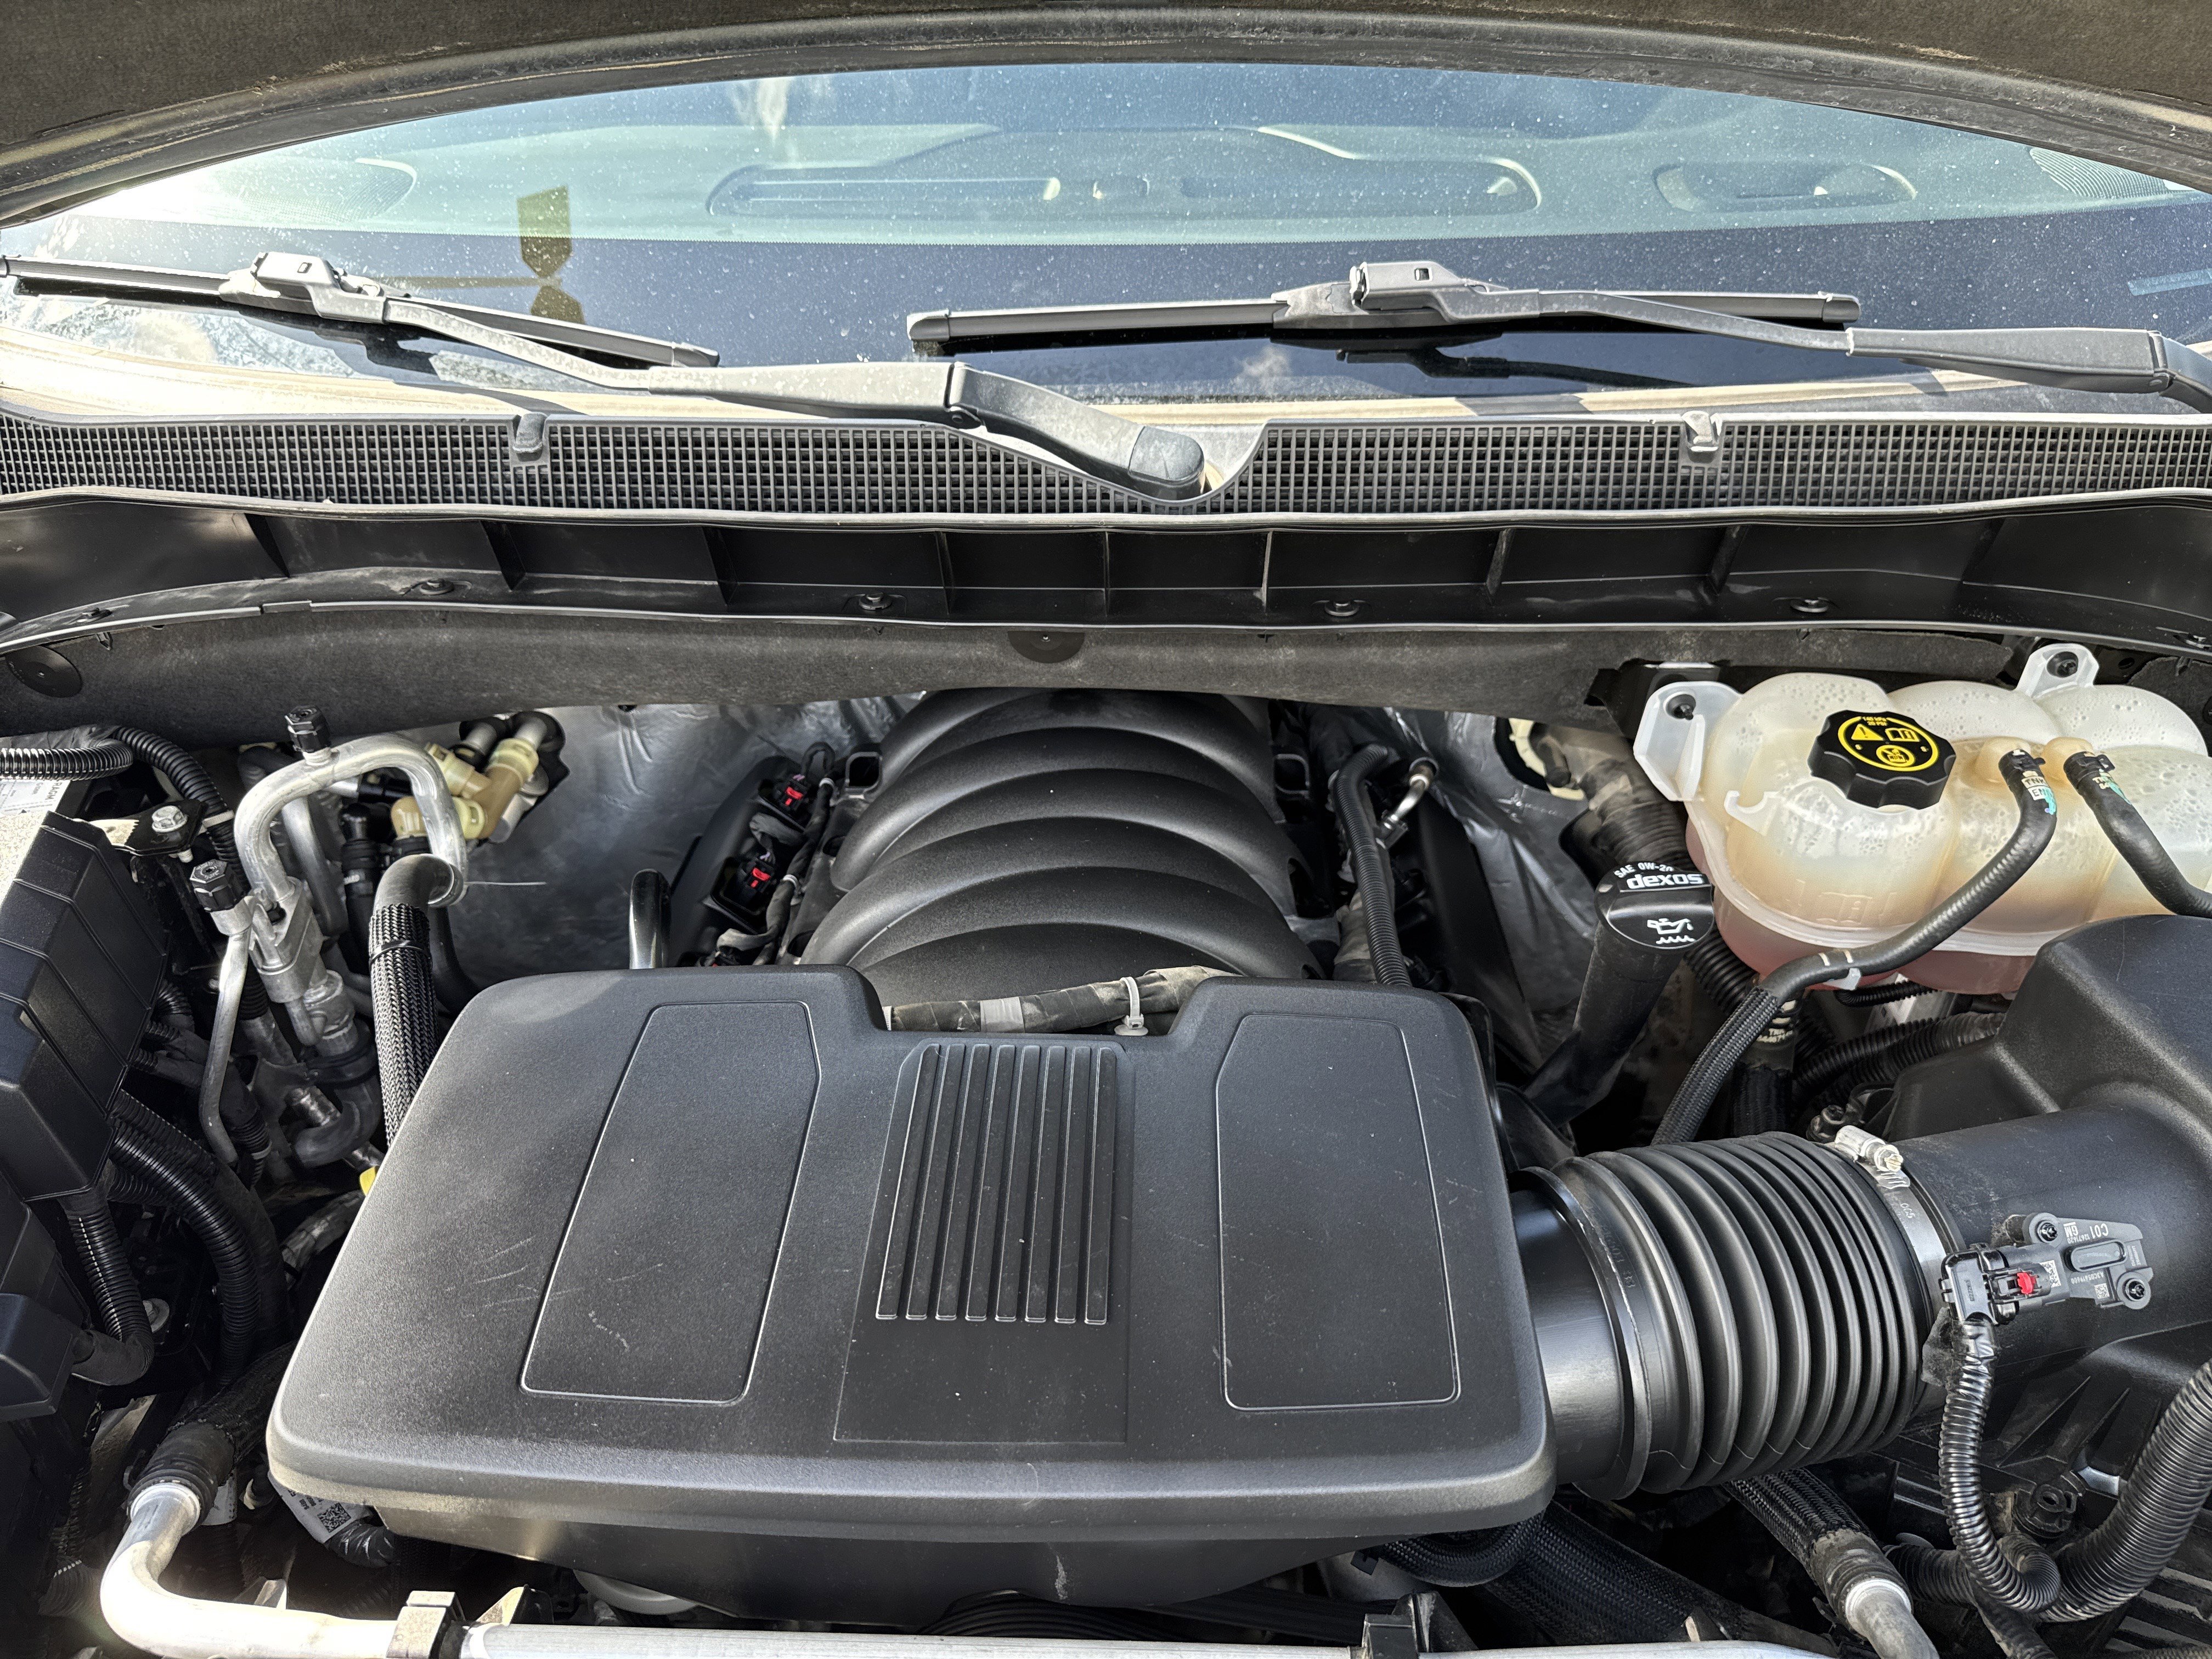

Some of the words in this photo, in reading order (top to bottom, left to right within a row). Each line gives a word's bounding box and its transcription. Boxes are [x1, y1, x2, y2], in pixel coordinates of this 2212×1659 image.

[1613, 864, 1637, 878] SAE
[1626, 873, 1703, 889] dexos
[2063, 1224, 2079, 1238] GM
[2067, 1233, 2090, 1244] 12671620
